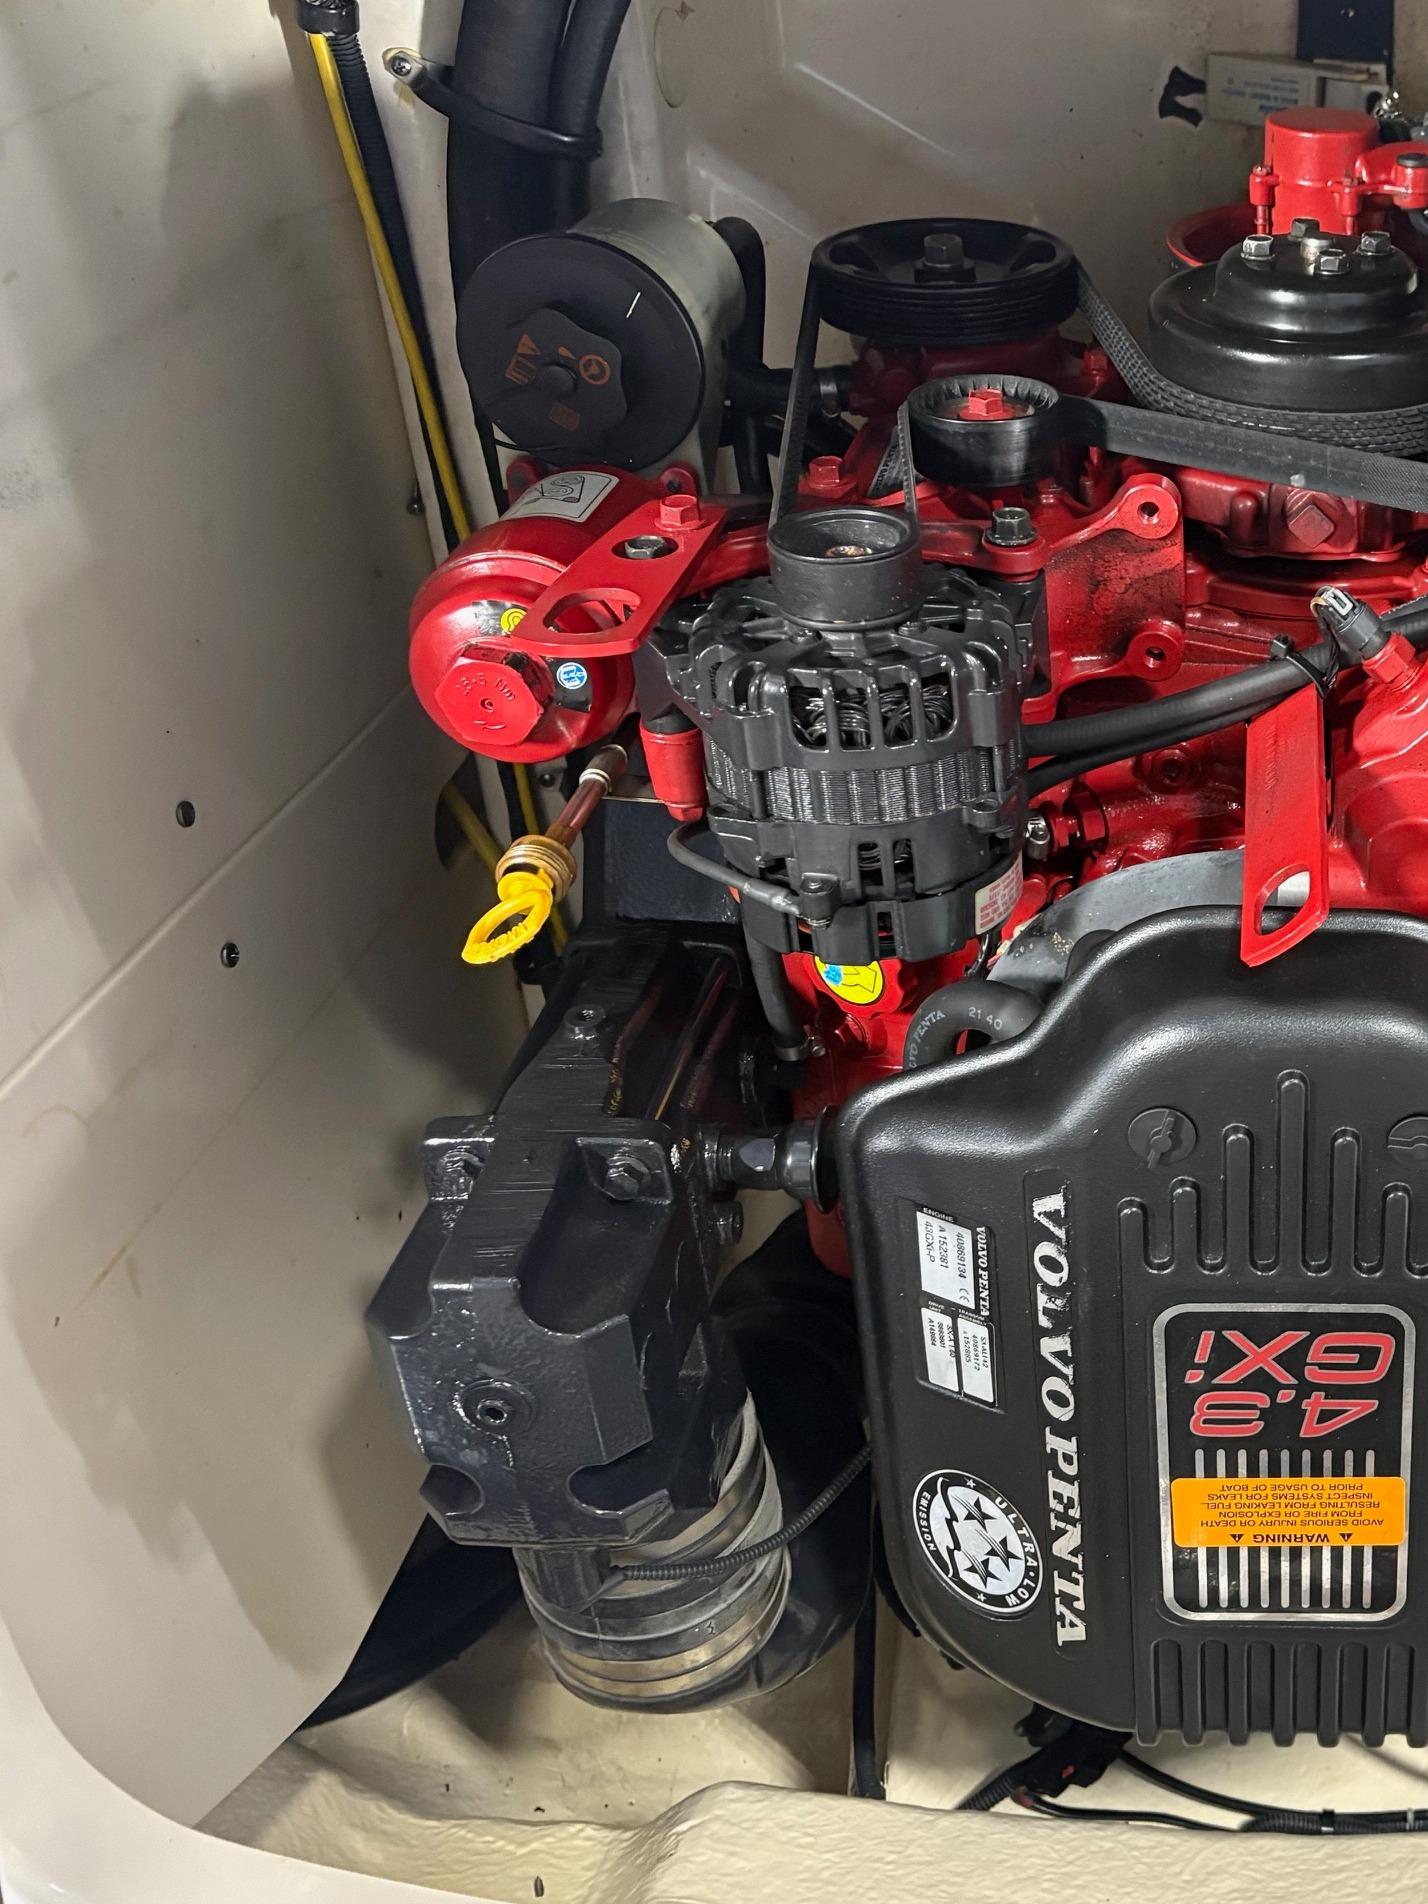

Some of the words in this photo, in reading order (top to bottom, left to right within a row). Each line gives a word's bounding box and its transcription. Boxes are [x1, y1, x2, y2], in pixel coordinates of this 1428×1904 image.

[914, 1010, 946, 1043] PENTA
[923, 1207, 955, 1223] ENGINE
[976, 1226, 988, 1271] VOLVO
[978, 1271, 990, 1317] PENTA
[1032, 1187, 1075, 1422] VOLVO
[1184, 1330, 1396, 1384] GXi
[1190, 1390, 1378, 1437] 4.3
[1220, 1484, 1248, 1492] BOAT
[1252, 1484, 1267, 1492] OF
[1329, 1483, 1363, 1491] PRIOR
[1207, 1493, 1243, 1501] LEAKS
[1326, 1492, 1373, 1500] INSPECT
[1319, 1501, 1380, 1509] RESULTING
[1218, 1511, 1281, 1519] EXPLOSION
[1331, 1510, 1363, 1518] FROM
[918, 1491, 936, 1551] EMISSION
[1045, 1426, 1087, 1648] PENTA
[1252, 1533, 1330, 1543] WARNING
